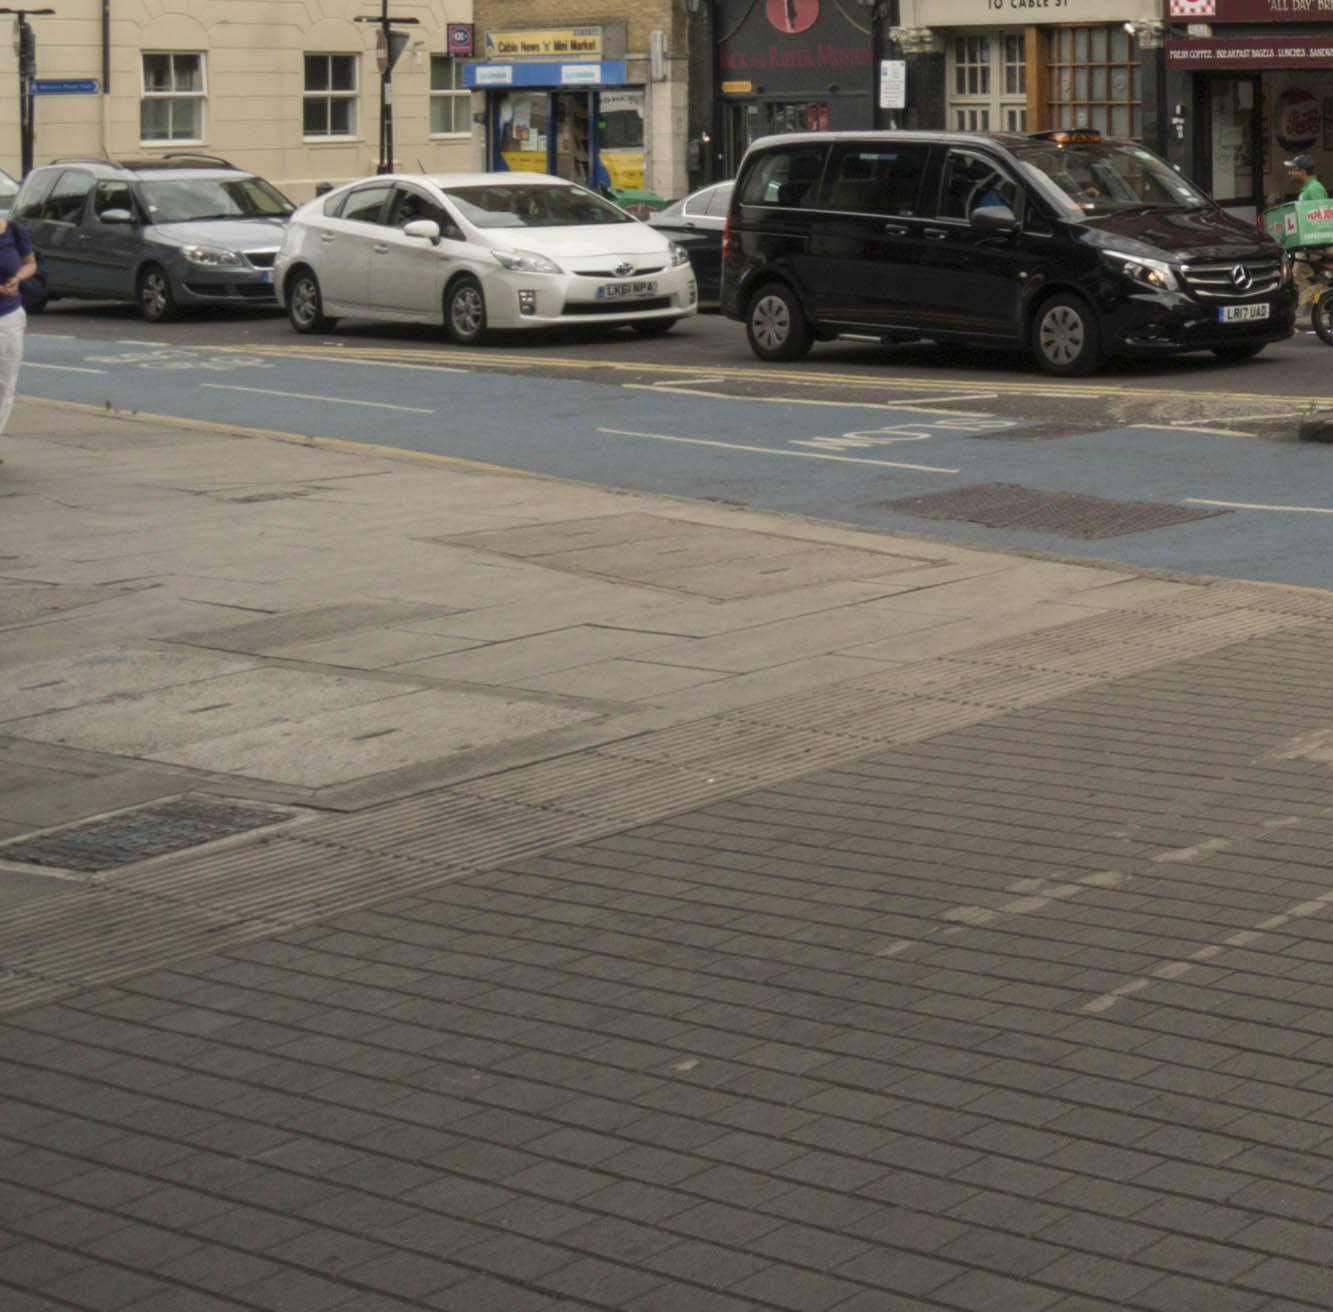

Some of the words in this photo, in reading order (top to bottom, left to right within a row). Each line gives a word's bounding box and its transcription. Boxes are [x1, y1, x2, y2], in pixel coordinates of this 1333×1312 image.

[498, 41, 519, 53] Cable
[521, 40, 540, 52] News
[570, 39, 596, 51] Market
[1216, 48, 1250, 59] BREAKFAST
[1251, 48, 1275, 58] BAGELS
[1278, 47, 1306, 58] LUNCHES
